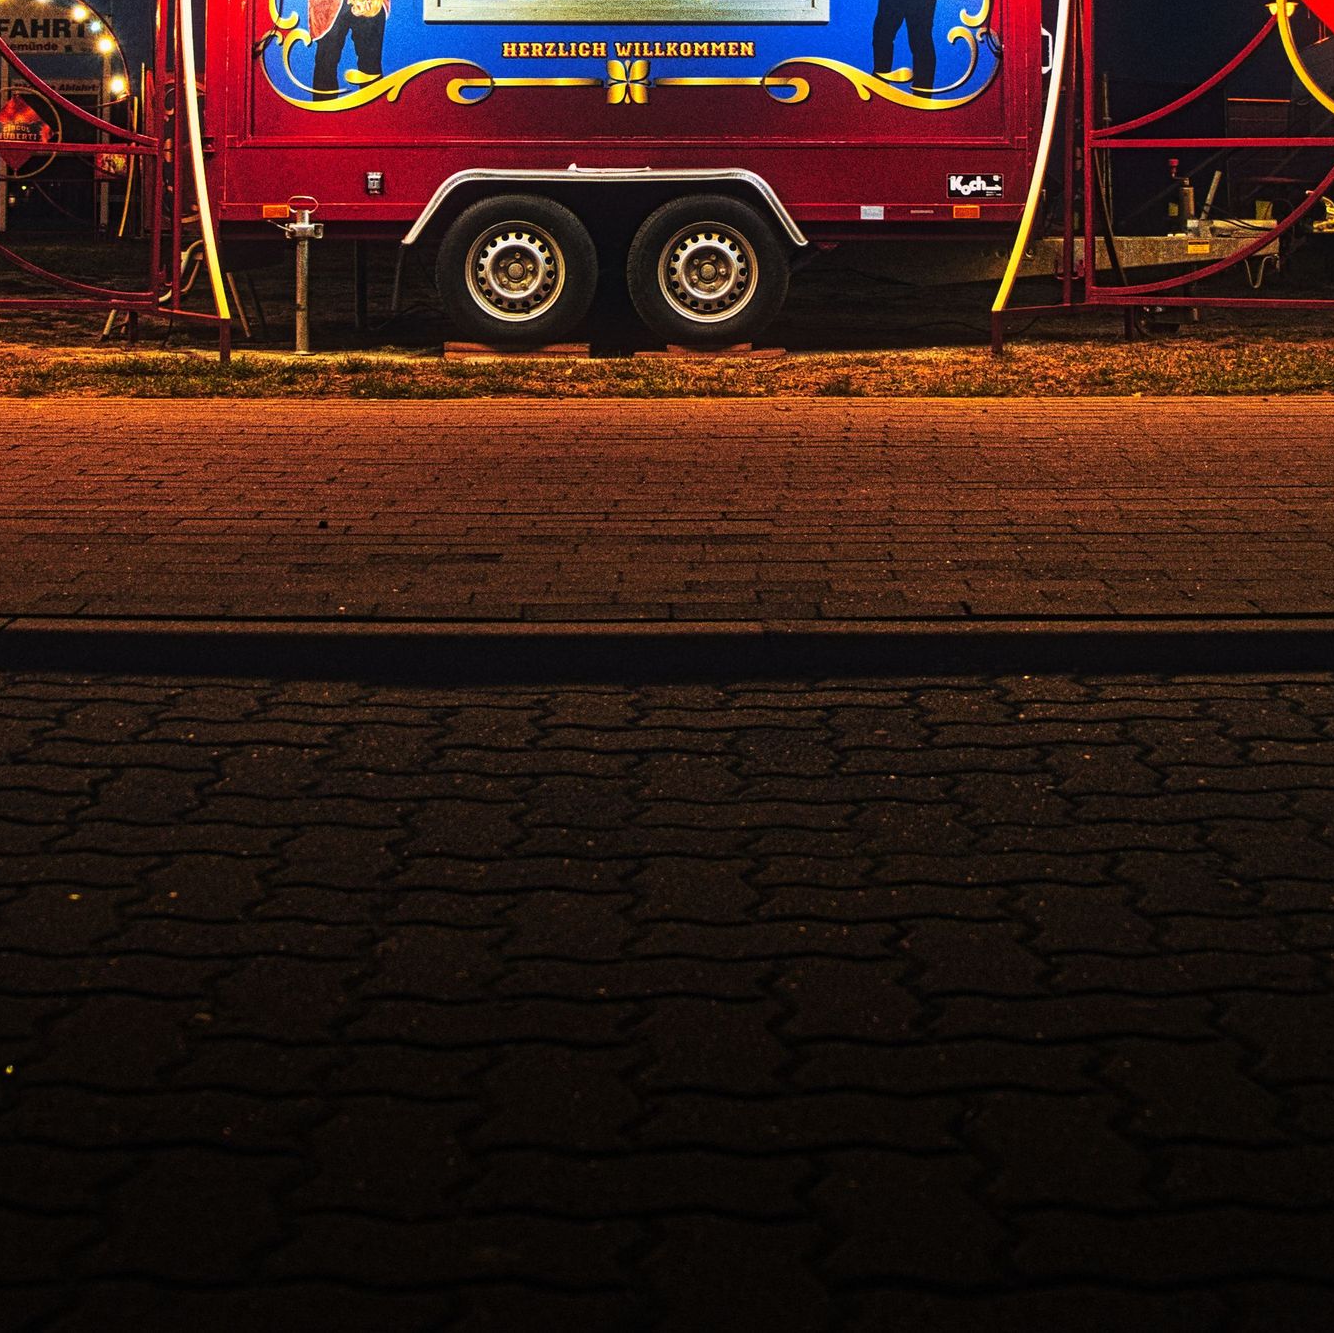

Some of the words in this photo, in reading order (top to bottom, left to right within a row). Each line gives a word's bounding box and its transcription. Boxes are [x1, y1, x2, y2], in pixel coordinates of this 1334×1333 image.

[502, 42, 607, 57] HERZLICH
[614, 42, 755, 57] WILLKOMMEN
[949, 175, 988, 196] Koch
